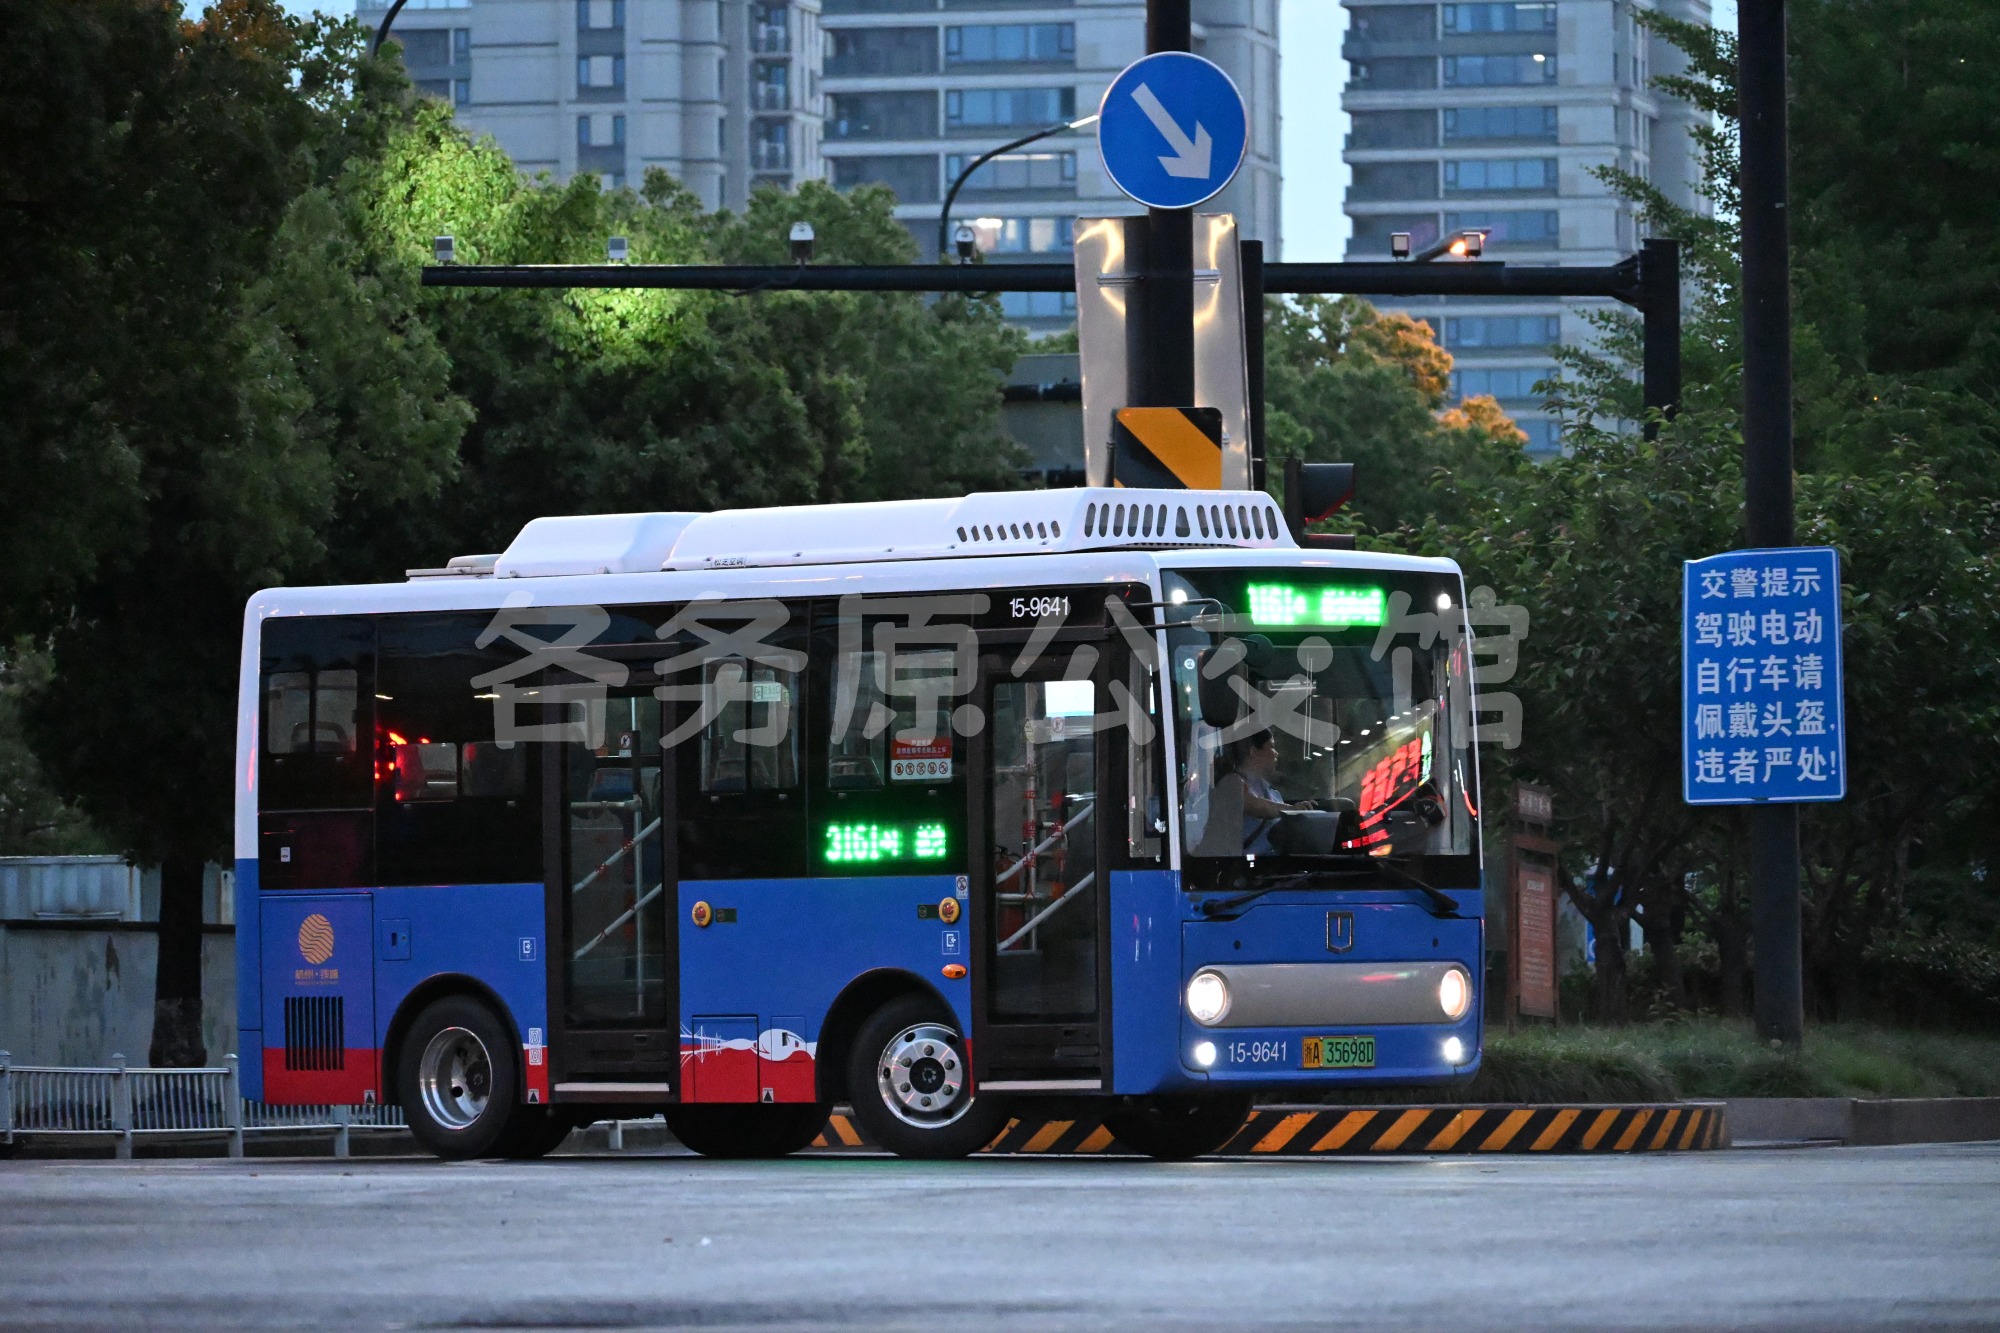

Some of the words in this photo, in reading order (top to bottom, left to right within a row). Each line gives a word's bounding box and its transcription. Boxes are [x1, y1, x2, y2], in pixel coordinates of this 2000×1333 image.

[1701, 567, 1821, 599] 交警提示
[1009, 596, 1068, 617] 15-9641
[1695, 608, 1823, 648] 驾驶电动
[1697, 653, 1824, 694] 自行车请
[1695, 746, 1836, 784] 违者严处！
[1228, 1041, 1287, 1063] 15-9641
